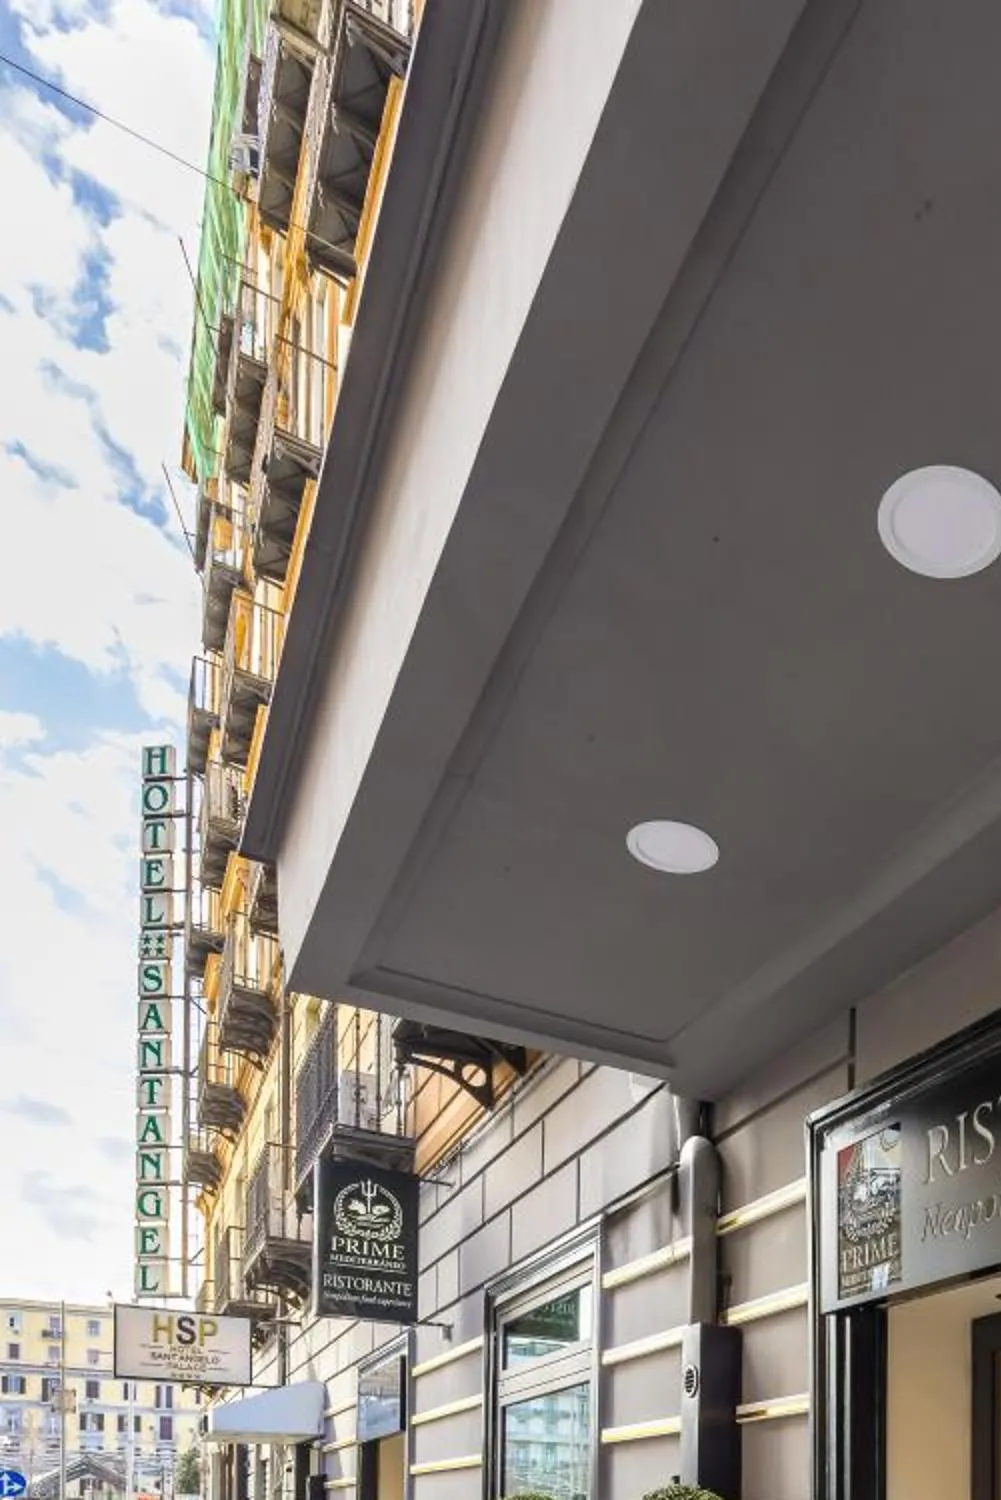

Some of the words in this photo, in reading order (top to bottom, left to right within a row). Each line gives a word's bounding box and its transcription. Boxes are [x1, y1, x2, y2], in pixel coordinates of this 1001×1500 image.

[143, 747, 169, 923] HOTEL
[331, 1235, 406, 1261] PRIME
[843, 1232, 898, 1273] PRIME
[323, 1273, 413, 1297] RISTORANTE
[152, 1313, 218, 1347] HSP
